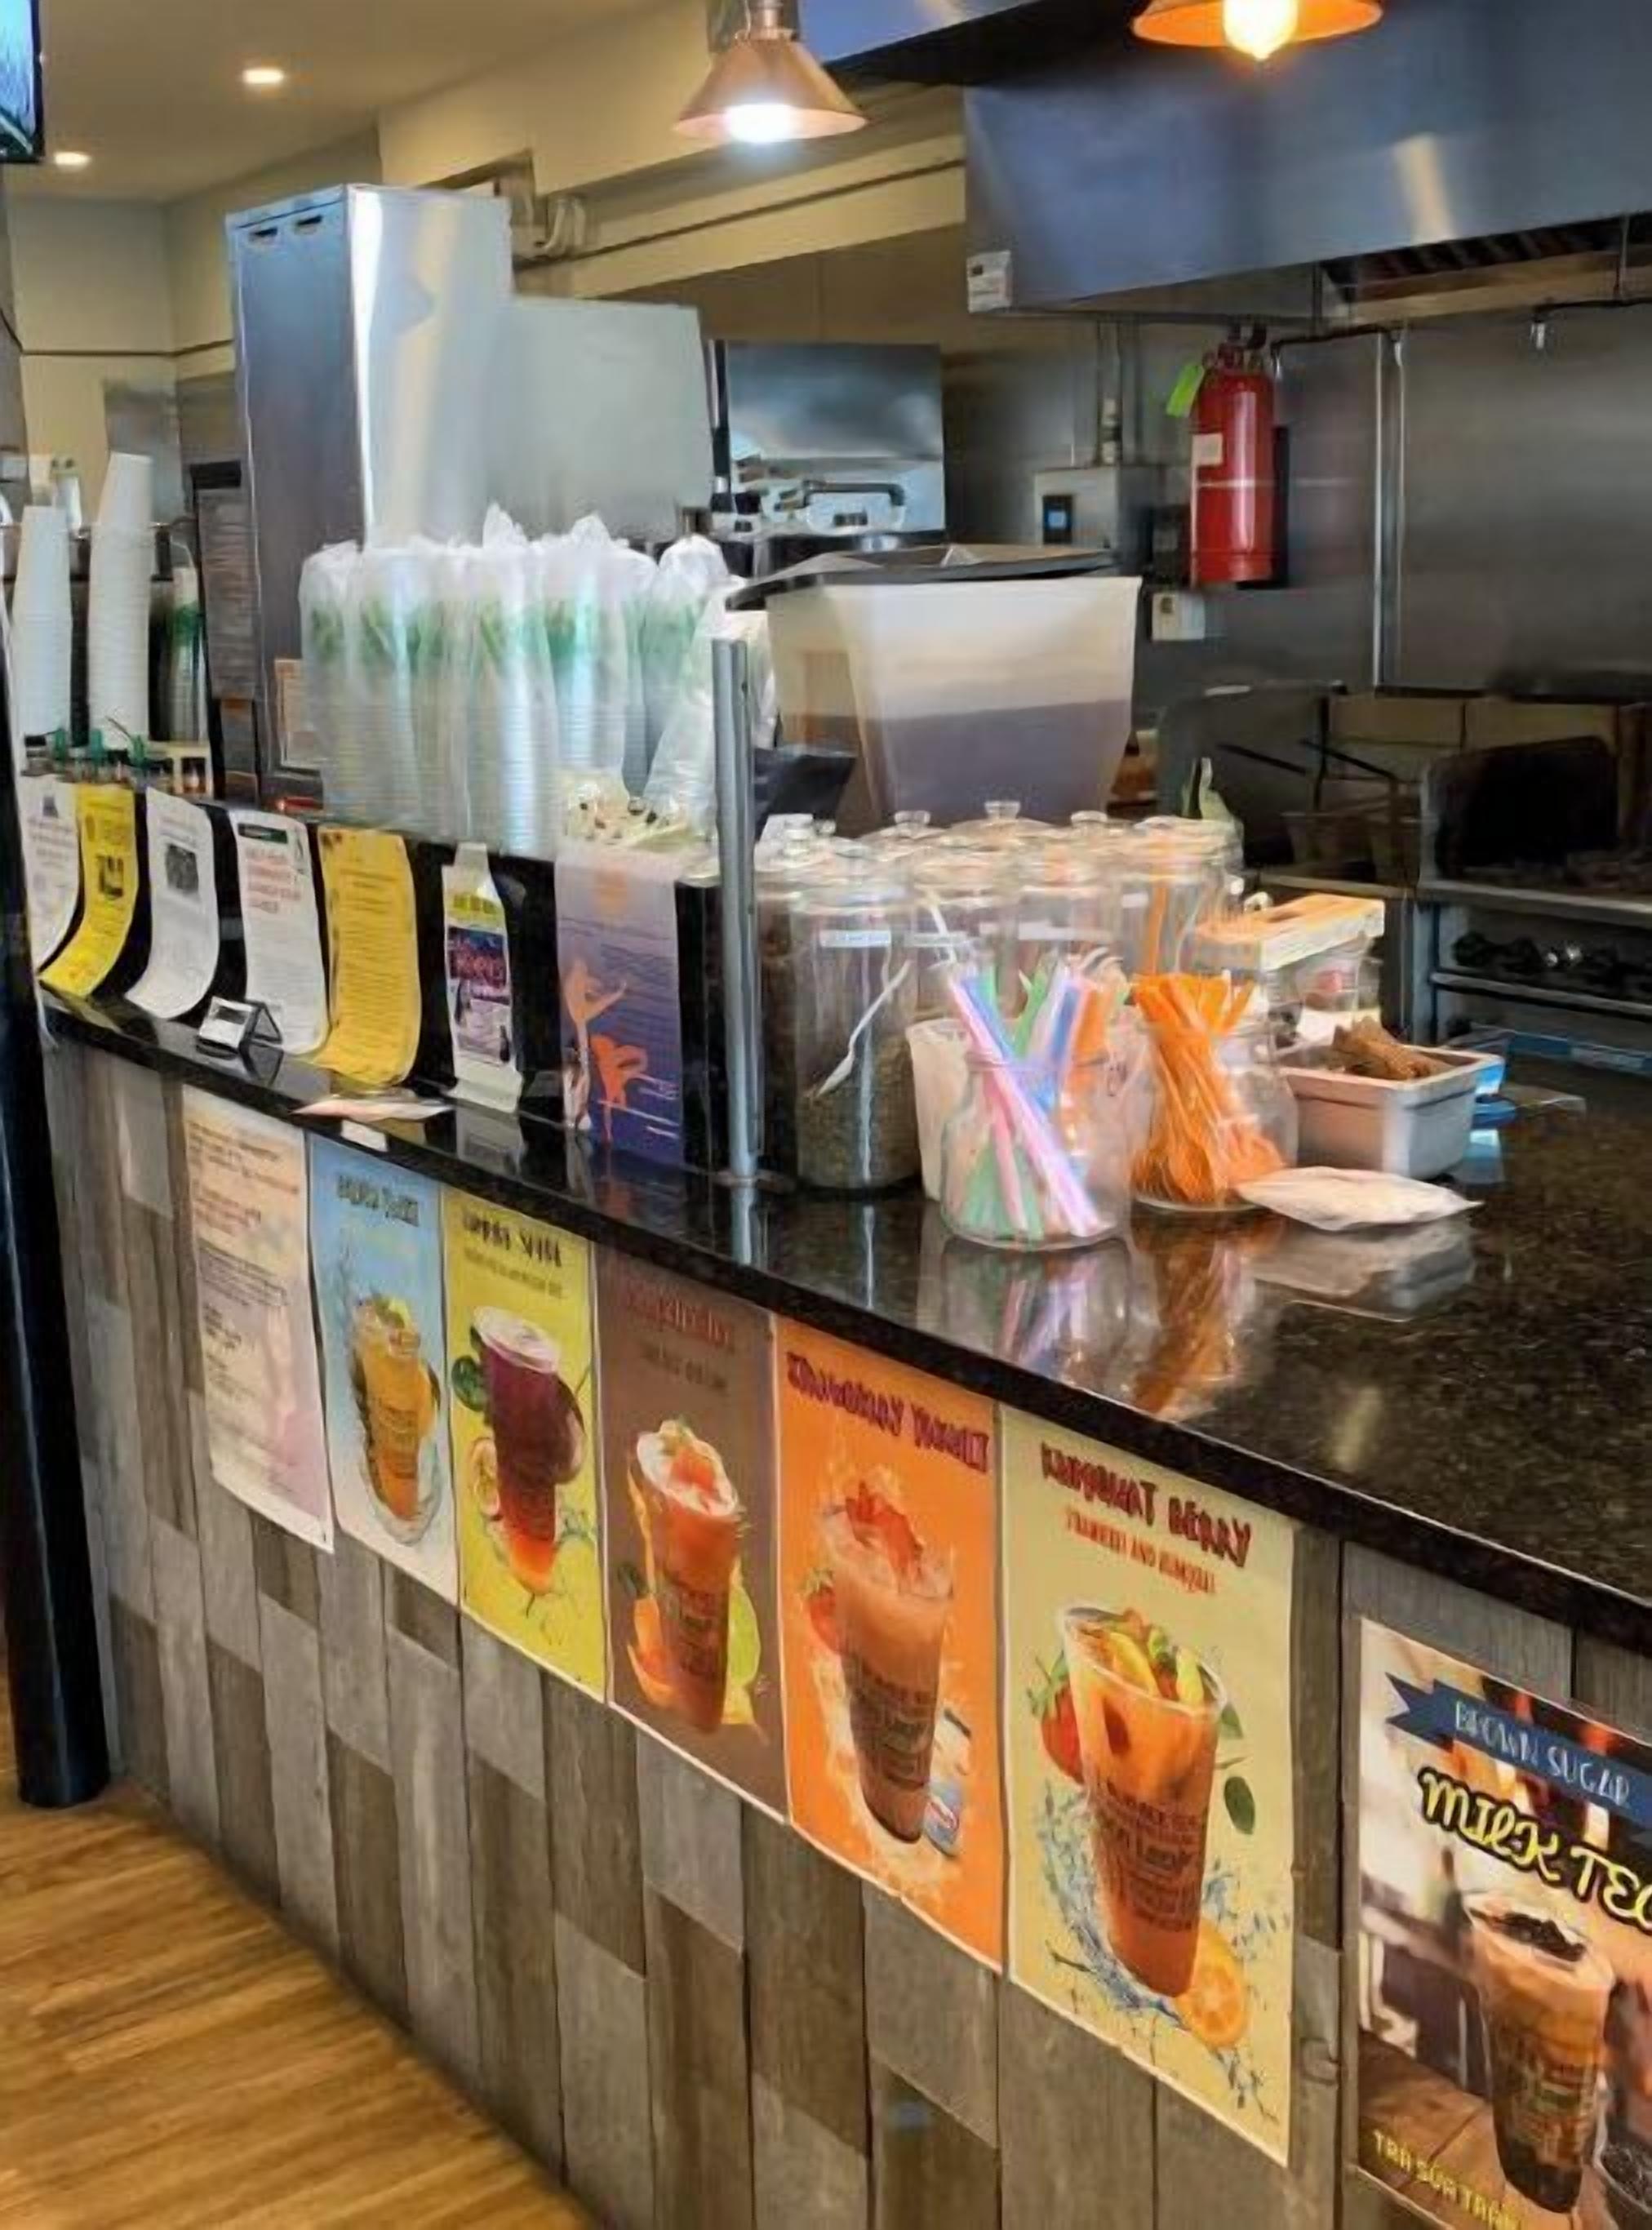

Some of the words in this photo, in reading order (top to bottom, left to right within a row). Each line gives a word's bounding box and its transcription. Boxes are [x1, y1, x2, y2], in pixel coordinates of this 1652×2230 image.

[1041, 1442, 1157, 1526] KUMQUAT
[1169, 1496, 1251, 1568] BERRY
[1455, 1700, 1539, 1766] BROWN
[1548, 1745, 1630, 1806] SUGAR
[1419, 1769, 1561, 1883] MILK
